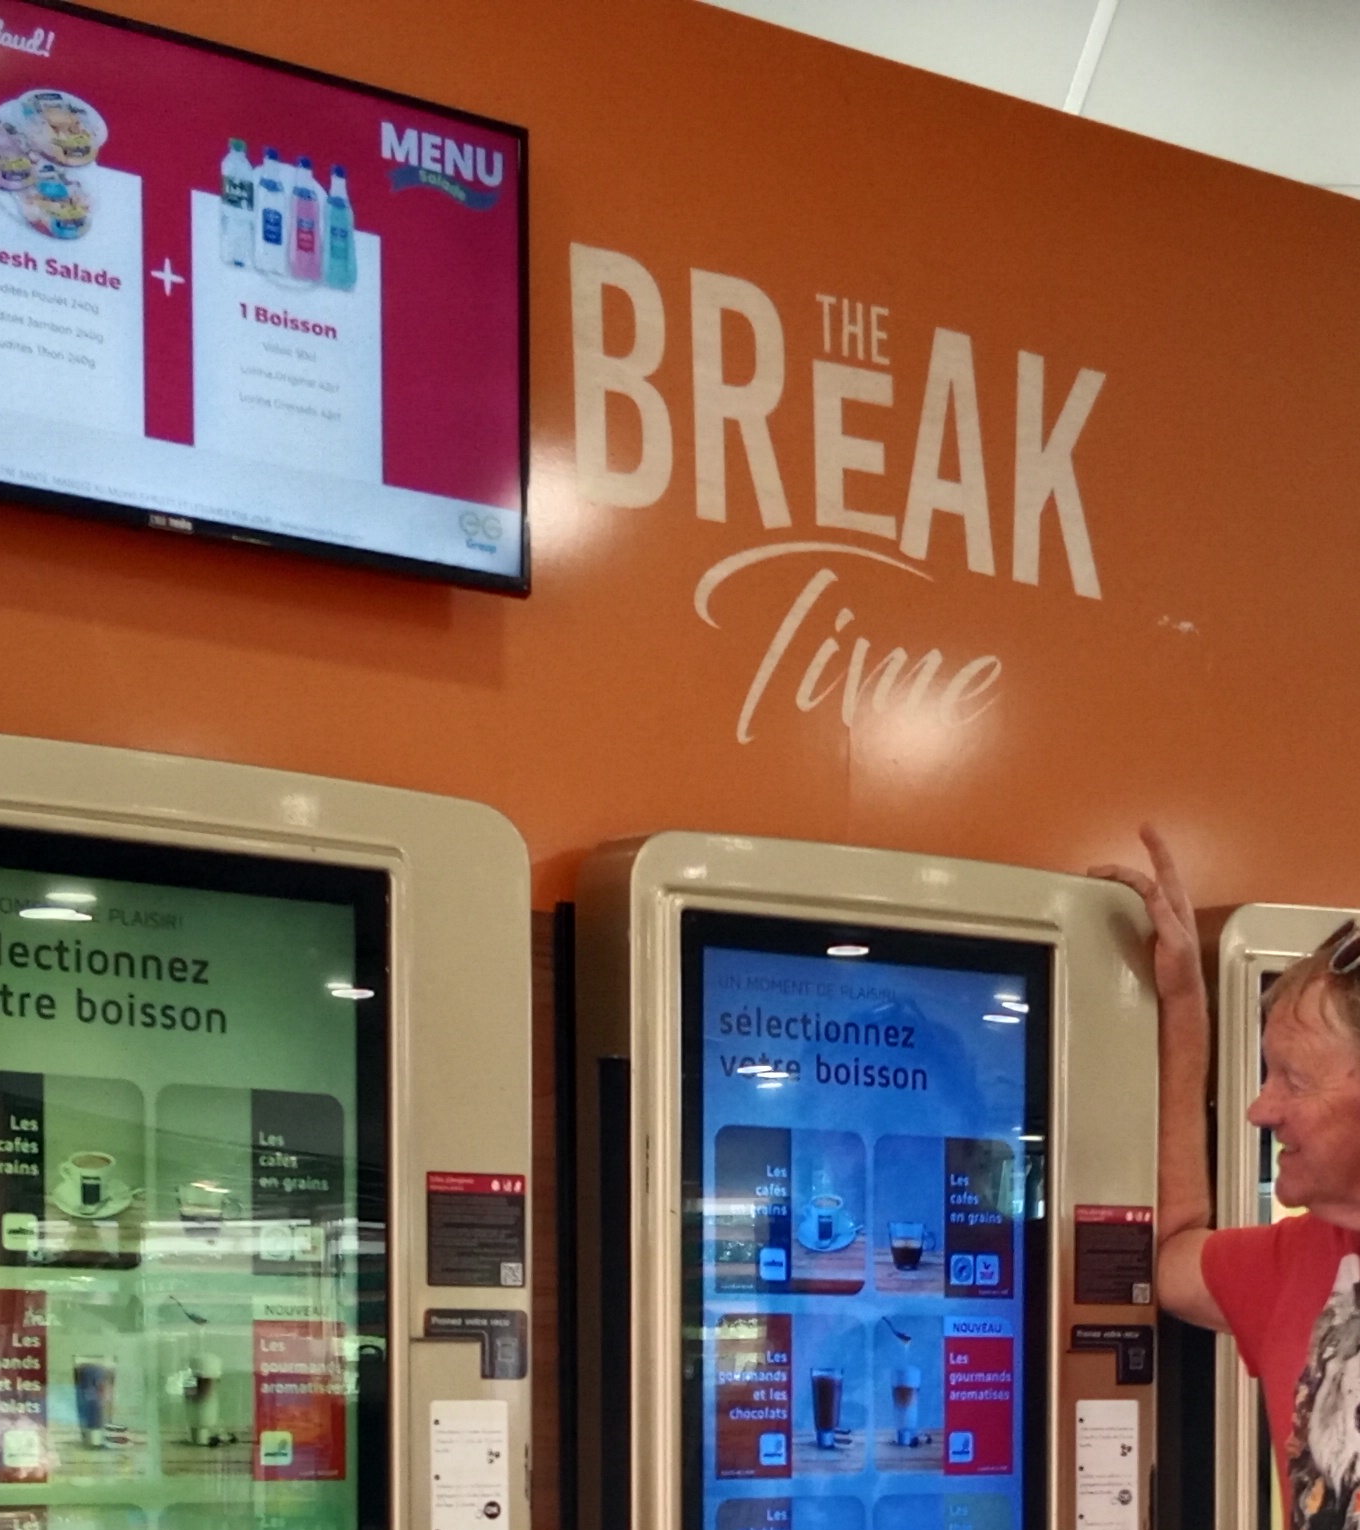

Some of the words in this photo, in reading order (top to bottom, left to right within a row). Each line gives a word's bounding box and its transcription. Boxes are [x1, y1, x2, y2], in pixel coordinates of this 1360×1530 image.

[381, 121, 504, 187] MENU
[45, 258, 122, 290] Salade
[240, 302, 248, 320] 1
[254, 306, 338, 340] Boisson
[815, 293, 891, 366] THE
[570, 241, 1107, 601] BREAK
[693, 541, 1004, 746] Time
[76, 988, 227, 1034] boisson
[720, 1005, 915, 1049] sélectionnez
[816, 1053, 928, 1091] boisson
[10, 1115, 39, 1132] Les
[259, 1130, 285, 1147] Les
[766, 1164, 788, 1178] Les
[259, 1177, 279, 1188] en
[283, 1176, 329, 1193] grains
[950, 1173, 969, 1187] Les
[950, 1212, 965, 1223] en
[968, 1211, 1002, 1226] grains
[952, 1322, 1002, 1333] NOUVEAU
[12, 1333, 41, 1348] Les
[766, 1350, 787, 1363] Les
[949, 1352, 969, 1364] Les
[16, 1376, 41, 1392] les
[949, 1369, 1011, 1385] gourmands
[753, 1389, 766, 1401] et
[769, 1388, 787, 1401] les
[729, 1406, 787, 1419] chocolats
[766, 1508, 787, 1521] Les
